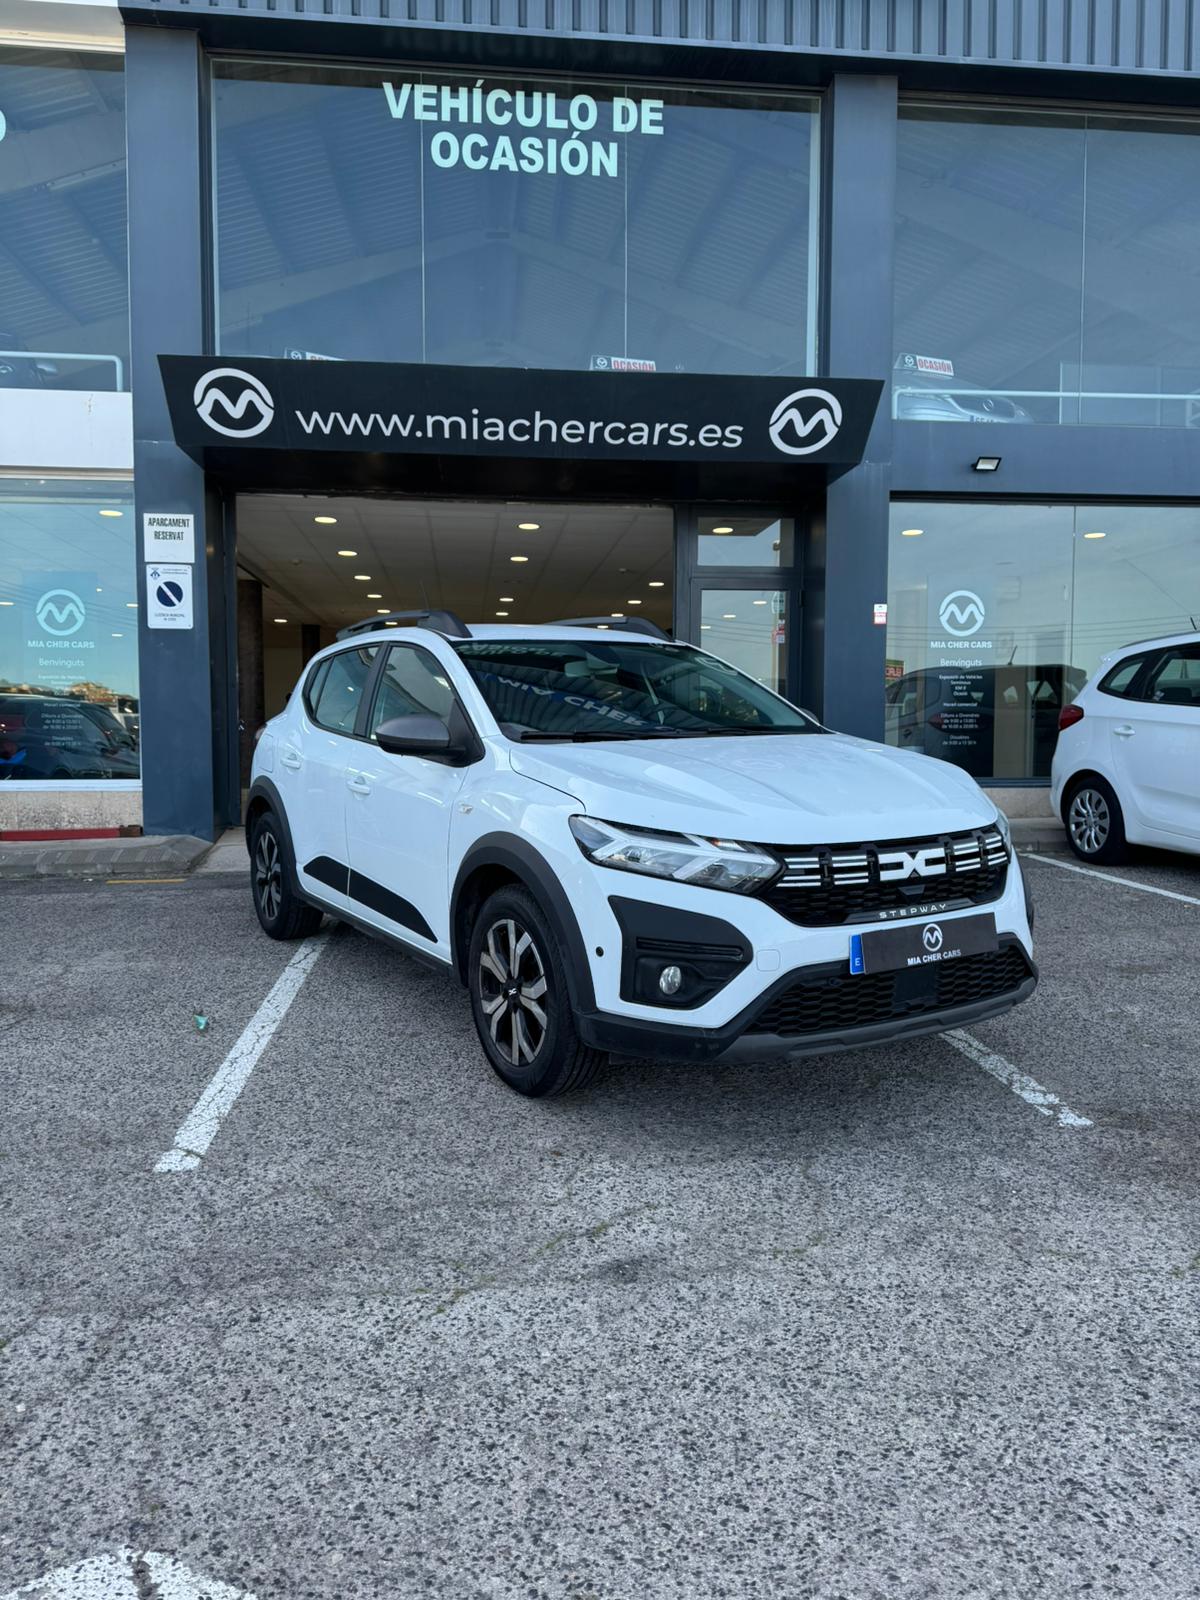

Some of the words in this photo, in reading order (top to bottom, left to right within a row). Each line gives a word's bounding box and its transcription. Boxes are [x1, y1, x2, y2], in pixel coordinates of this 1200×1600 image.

[382, 79, 598, 131] VEHÍCULO
[613, 97, 665, 135] DE
[430, 130, 618, 178] OCASIÓN
[295, 409, 744, 448] www.miachercars.es
[148, 517, 190, 528] APARCAMENT
[154, 530, 184, 540] RESERVAT
[27, 640, 45, 648] MIA
[46, 640, 70, 649] CHER
[71, 640, 95, 649] CARS
[930, 640, 946, 649] MIA
[947, 640, 970, 649] CHER
[970, 640, 993, 649] CARS
[39, 657, 85, 669] Benvinguts
[940, 658, 982, 669] Benvinguts
[879, 903, 947, 919] STEPWAY
[854, 957, 861, 966] E
[907, 956, 922, 966] MIA
[922, 952, 942, 963] CHER
[942, 949, 962, 960] CARS
